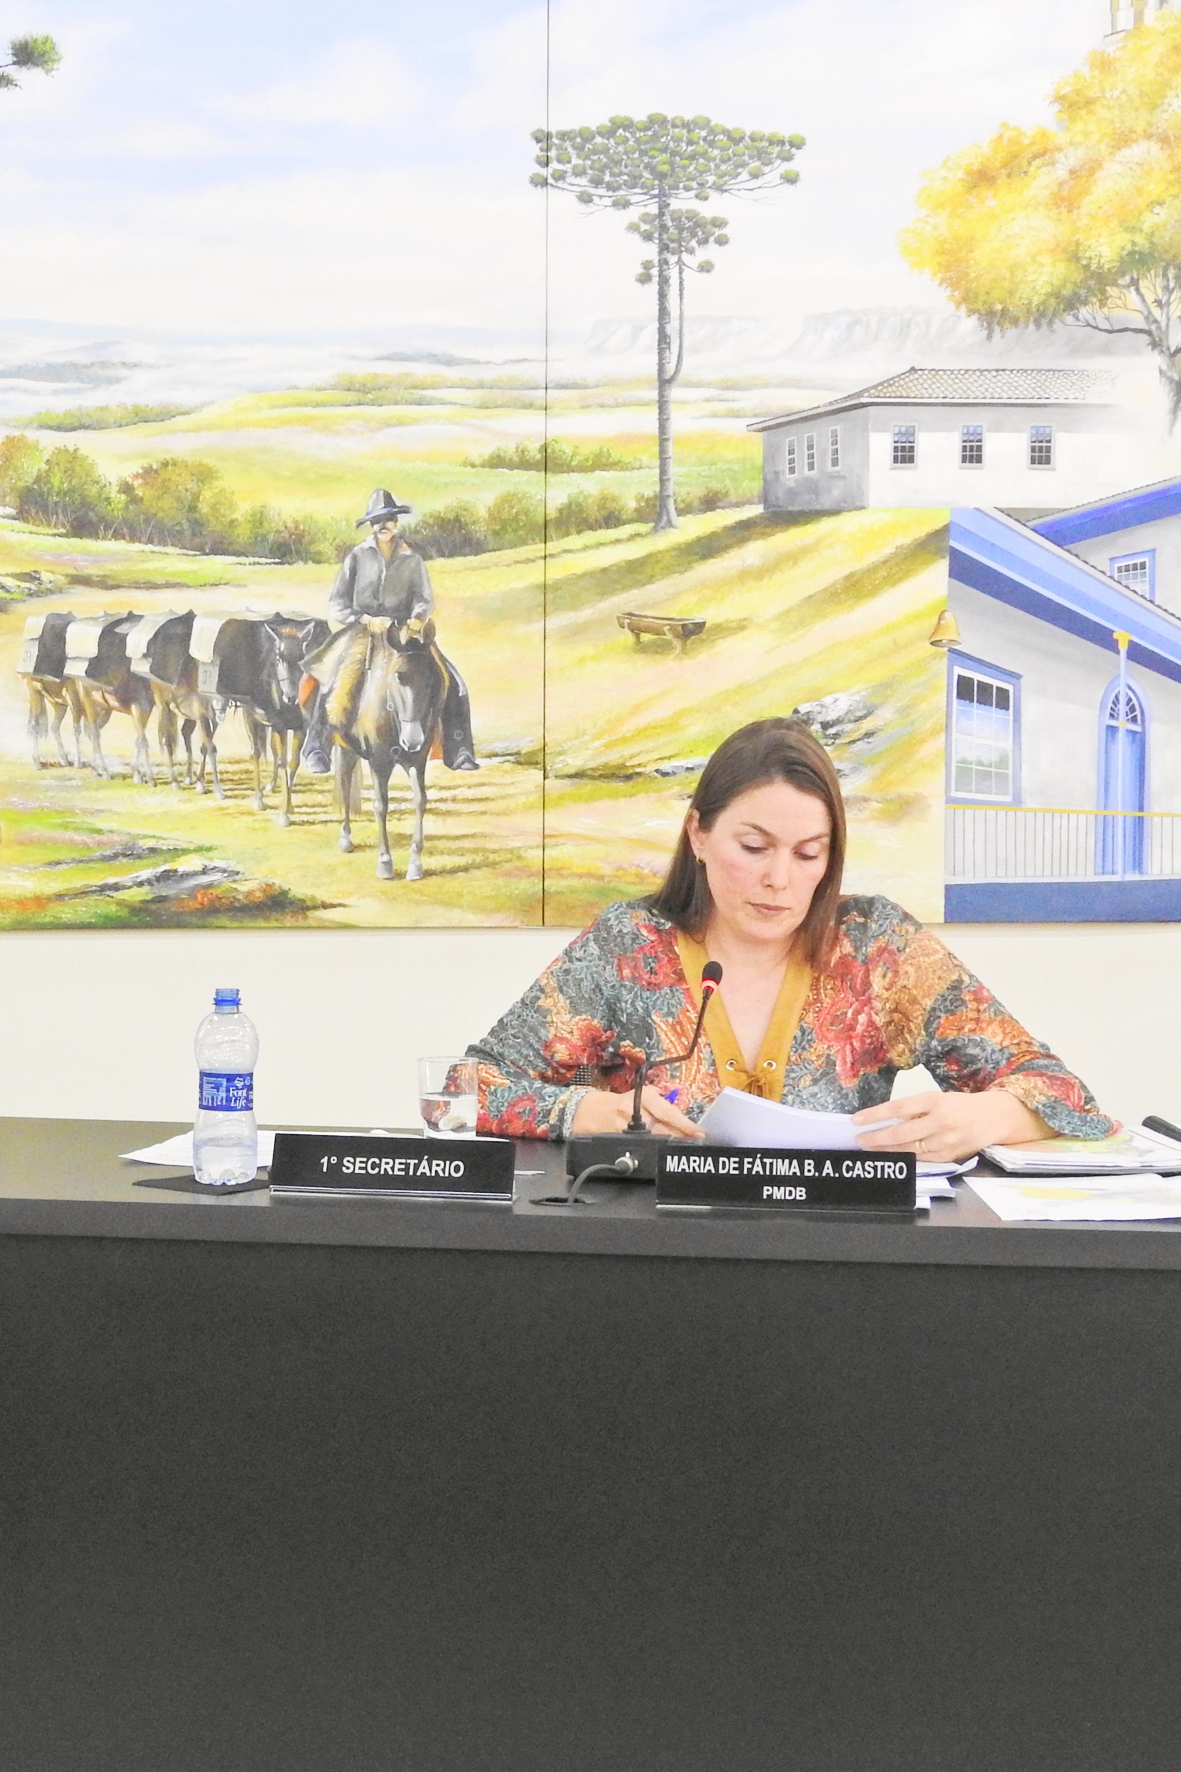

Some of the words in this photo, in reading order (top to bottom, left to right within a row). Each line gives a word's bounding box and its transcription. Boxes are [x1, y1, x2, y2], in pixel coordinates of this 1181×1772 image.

[229, 1086, 248, 1098] Font
[230, 1096, 247, 1109] Life
[341, 1155, 465, 1178] SECRETÁRIO
[665, 1155, 716, 1174] MARIA
[718, 1157, 740, 1175] DE
[743, 1154, 801, 1177] FÁTIMA
[803, 1159, 819, 1177] B.
[821, 1160, 839, 1178] A.
[842, 1161, 908, 1180] CASTRO
[762, 1186, 807, 1201] PMDB
